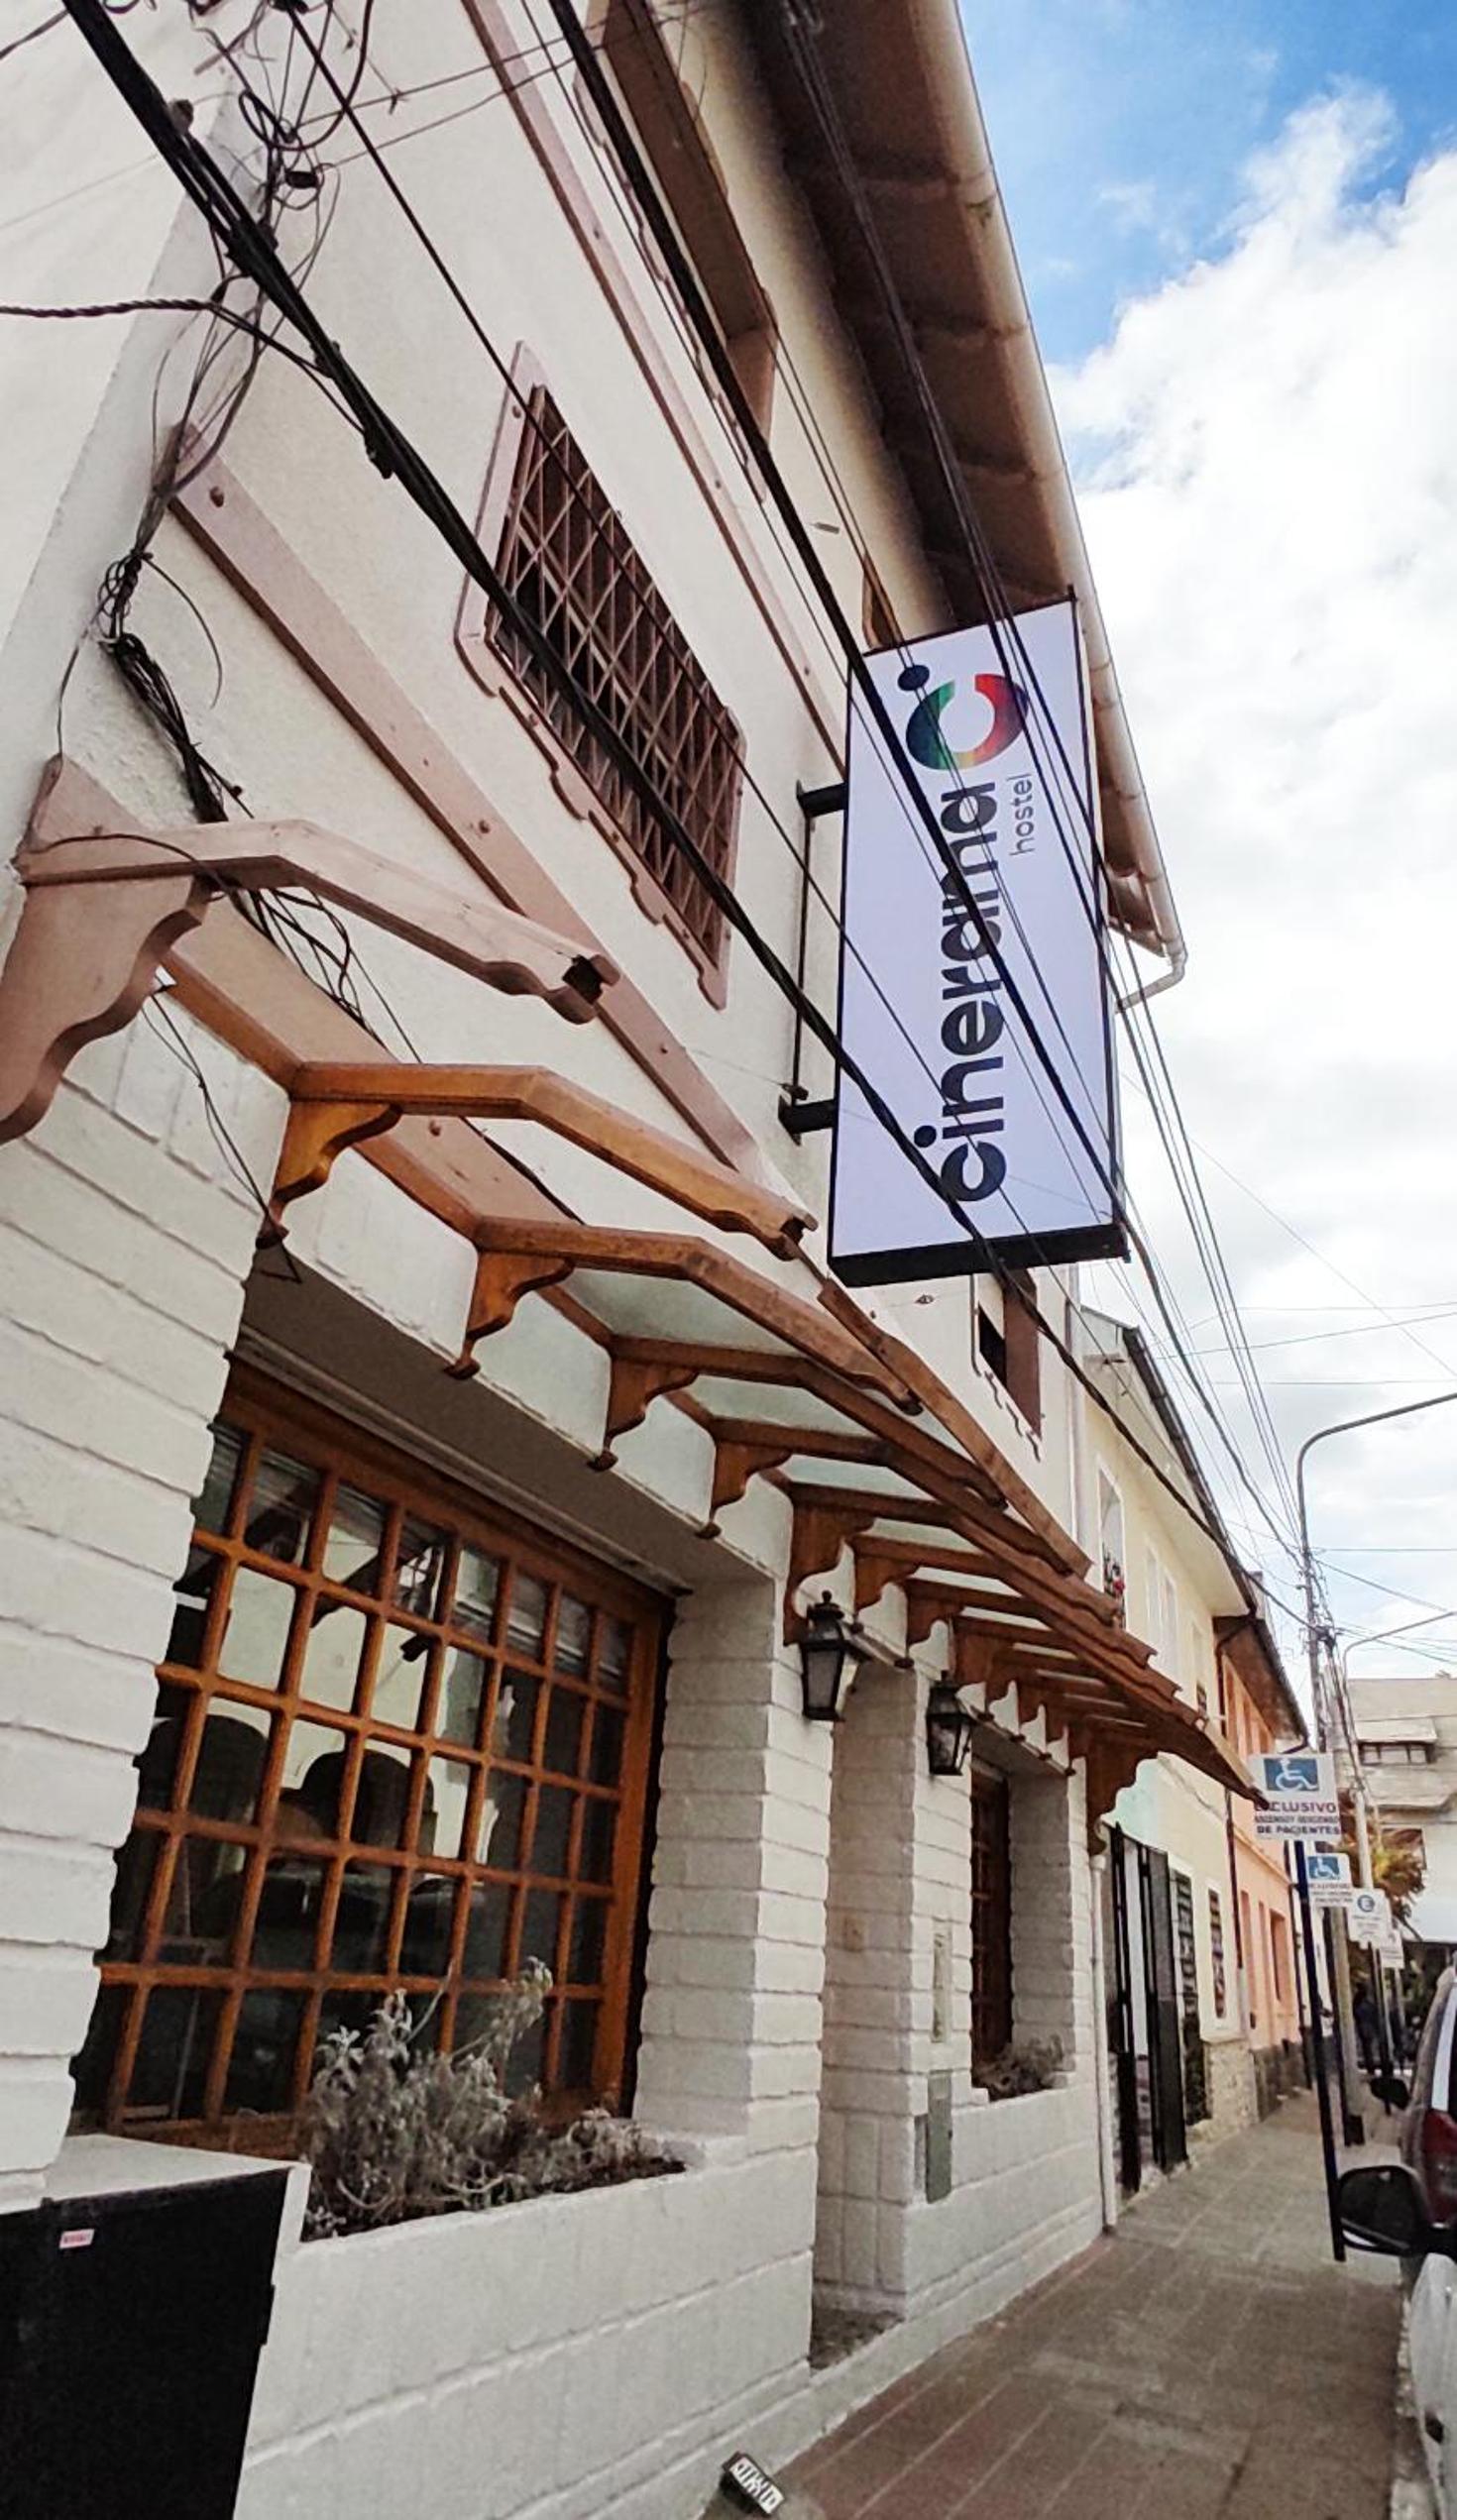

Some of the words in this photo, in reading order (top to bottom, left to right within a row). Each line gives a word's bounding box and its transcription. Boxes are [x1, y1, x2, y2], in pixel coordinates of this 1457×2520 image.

[1006, 773, 1036, 857] hostel
[913, 782, 1007, 1202] cinerama
[1255, 1801, 1337, 1812] CLUSIVO
[1276, 1825, 1340, 1835] PACIENTES
